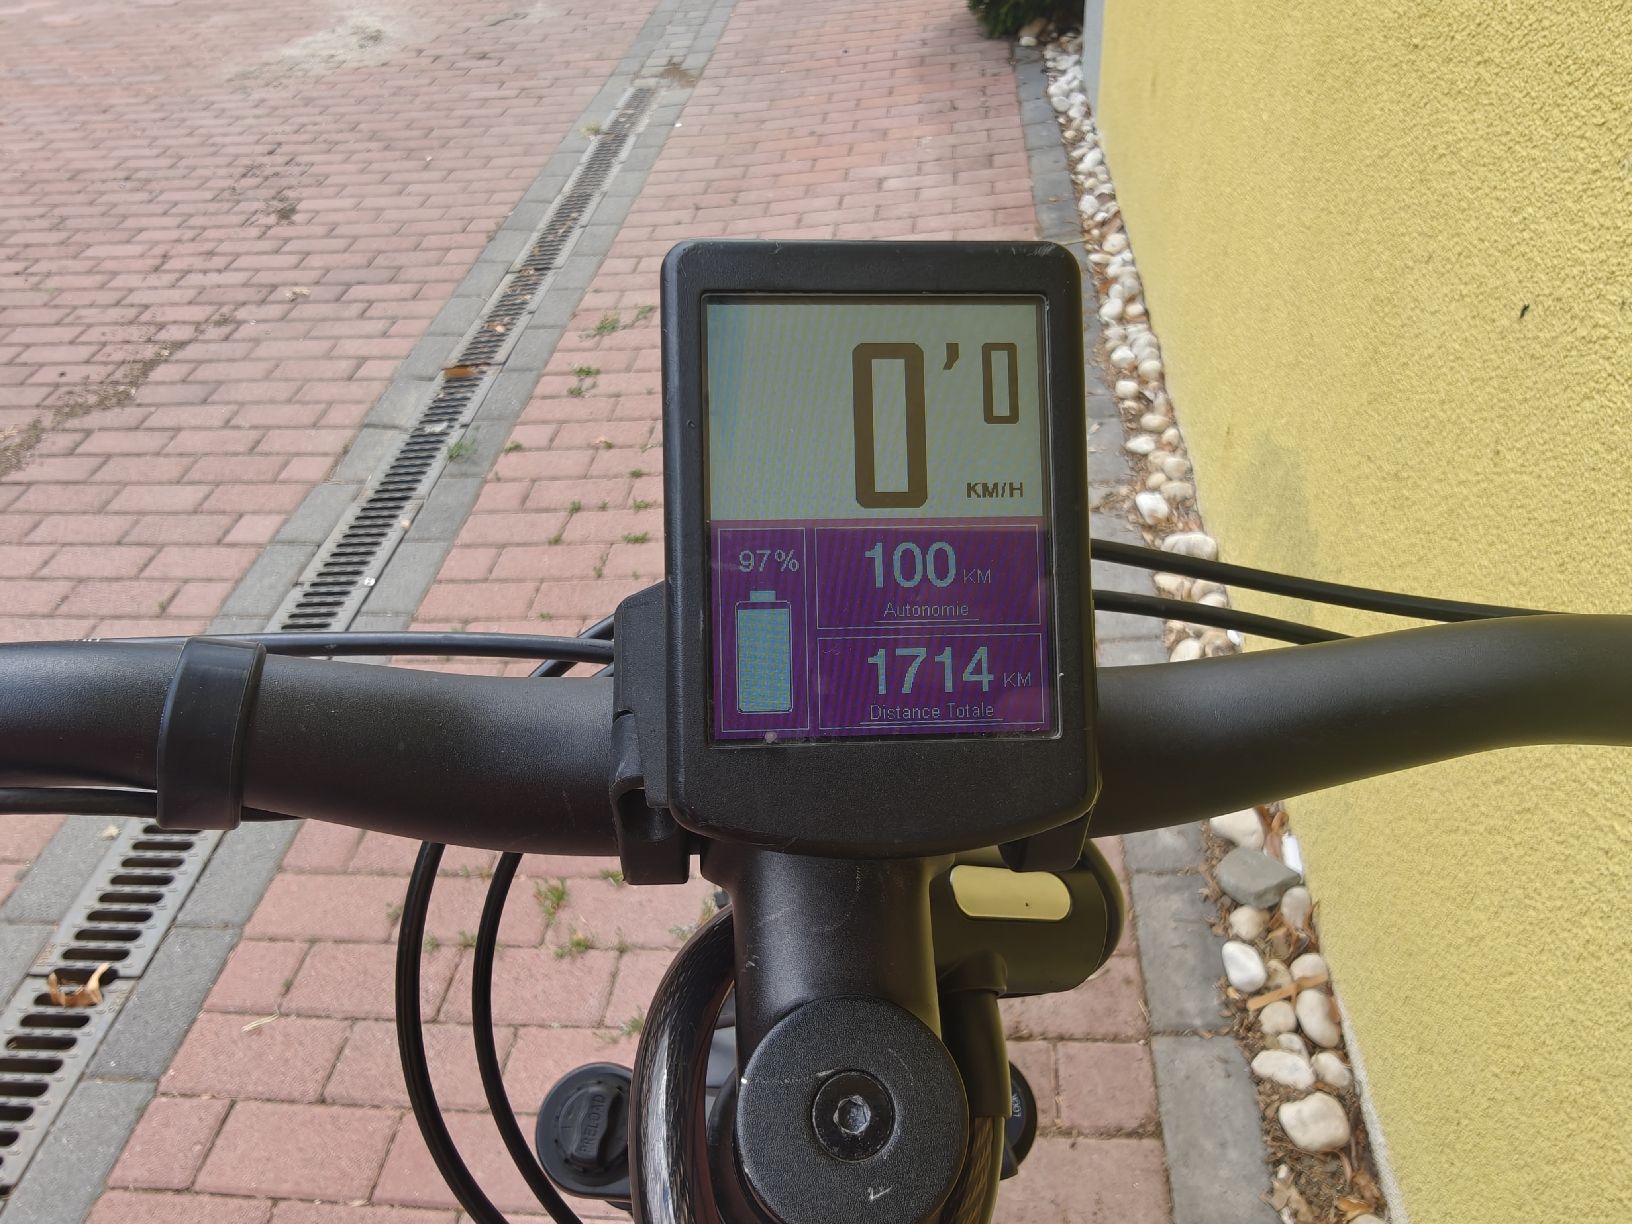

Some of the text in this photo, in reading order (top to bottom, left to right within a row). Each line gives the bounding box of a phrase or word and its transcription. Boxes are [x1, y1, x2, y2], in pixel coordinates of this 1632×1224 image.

[966, 481, 1025, 499] KM/H
[737, 549, 800, 573] 97%
[864, 541, 992, 589] 100 KM
[882, 601, 970, 618] Autonomie
[867, 645, 1032, 695] 1714 KM
[869, 701, 995, 721] Distance Totale
[580, 1093, 607, 1154] PRELOAD
